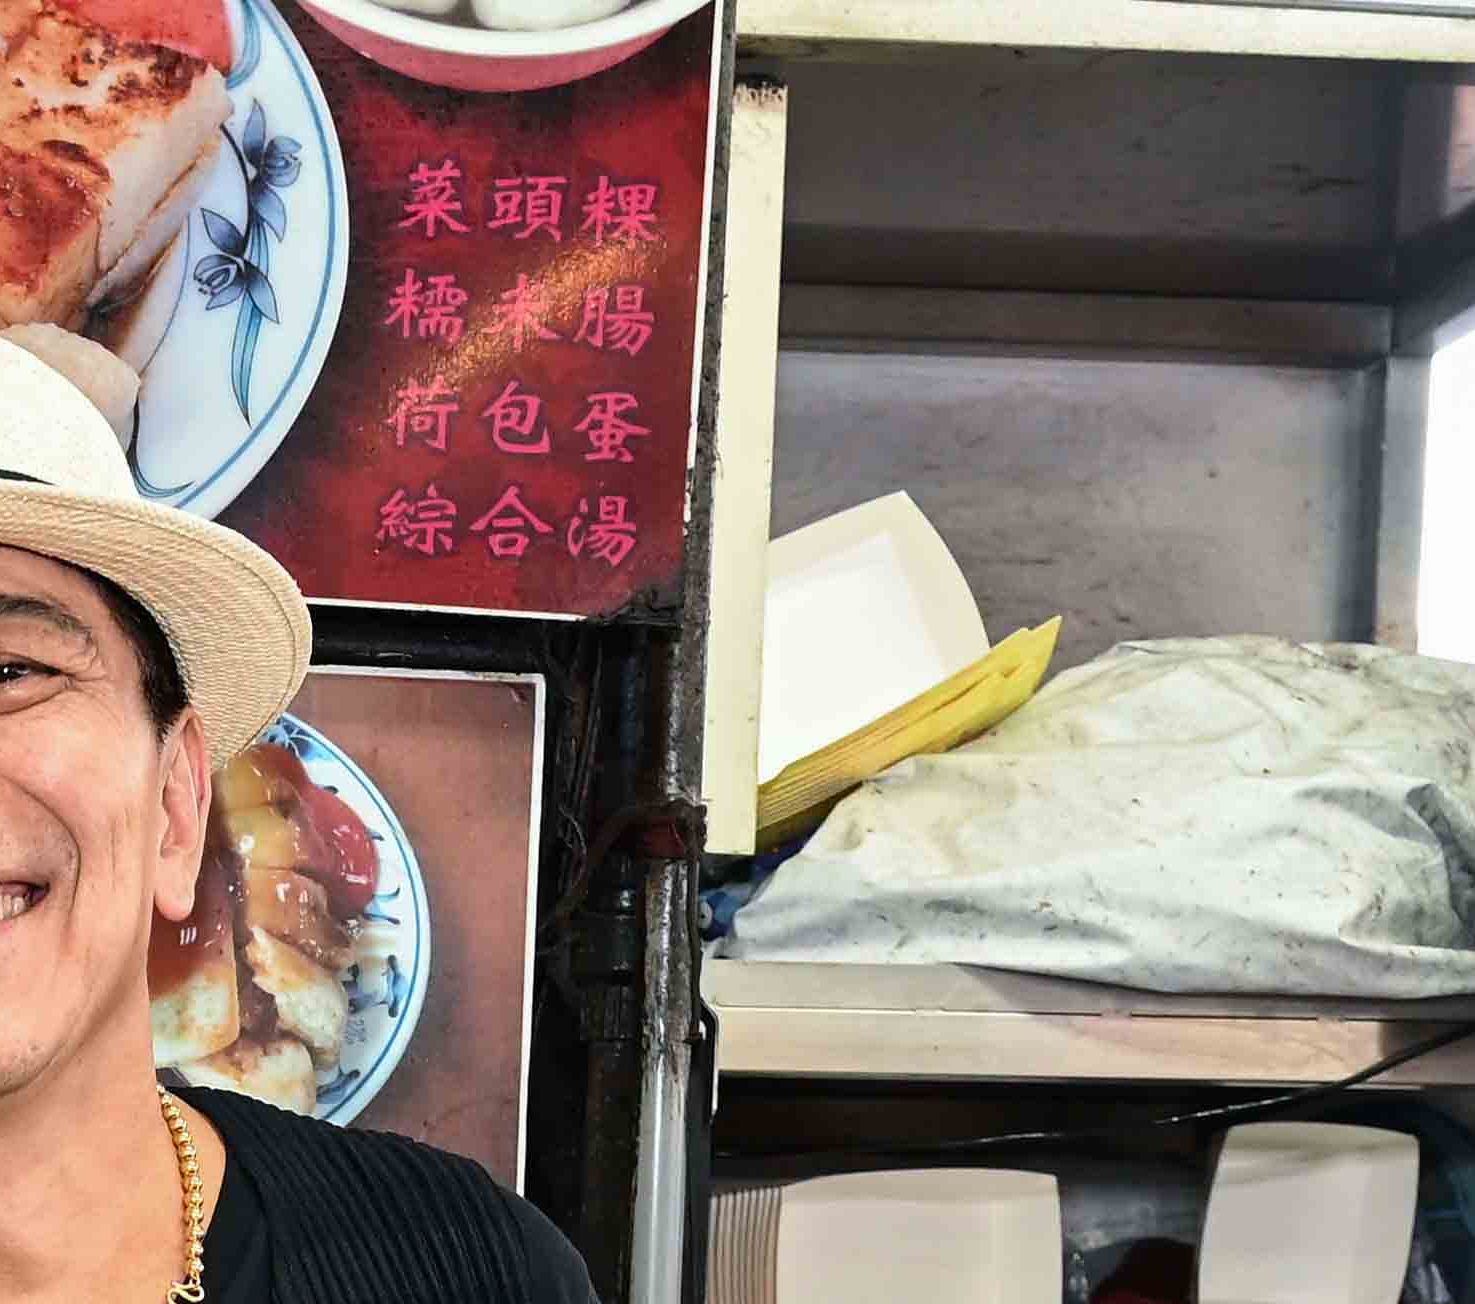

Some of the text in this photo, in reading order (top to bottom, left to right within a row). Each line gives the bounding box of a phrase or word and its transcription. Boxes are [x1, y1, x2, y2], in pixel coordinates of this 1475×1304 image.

[397, 158, 658, 243] 菜頭粿
[384, 268, 656, 357] 糯米腸
[388, 374, 652, 464] 荷包蛋
[375, 483, 638, 567] 綜合湯
